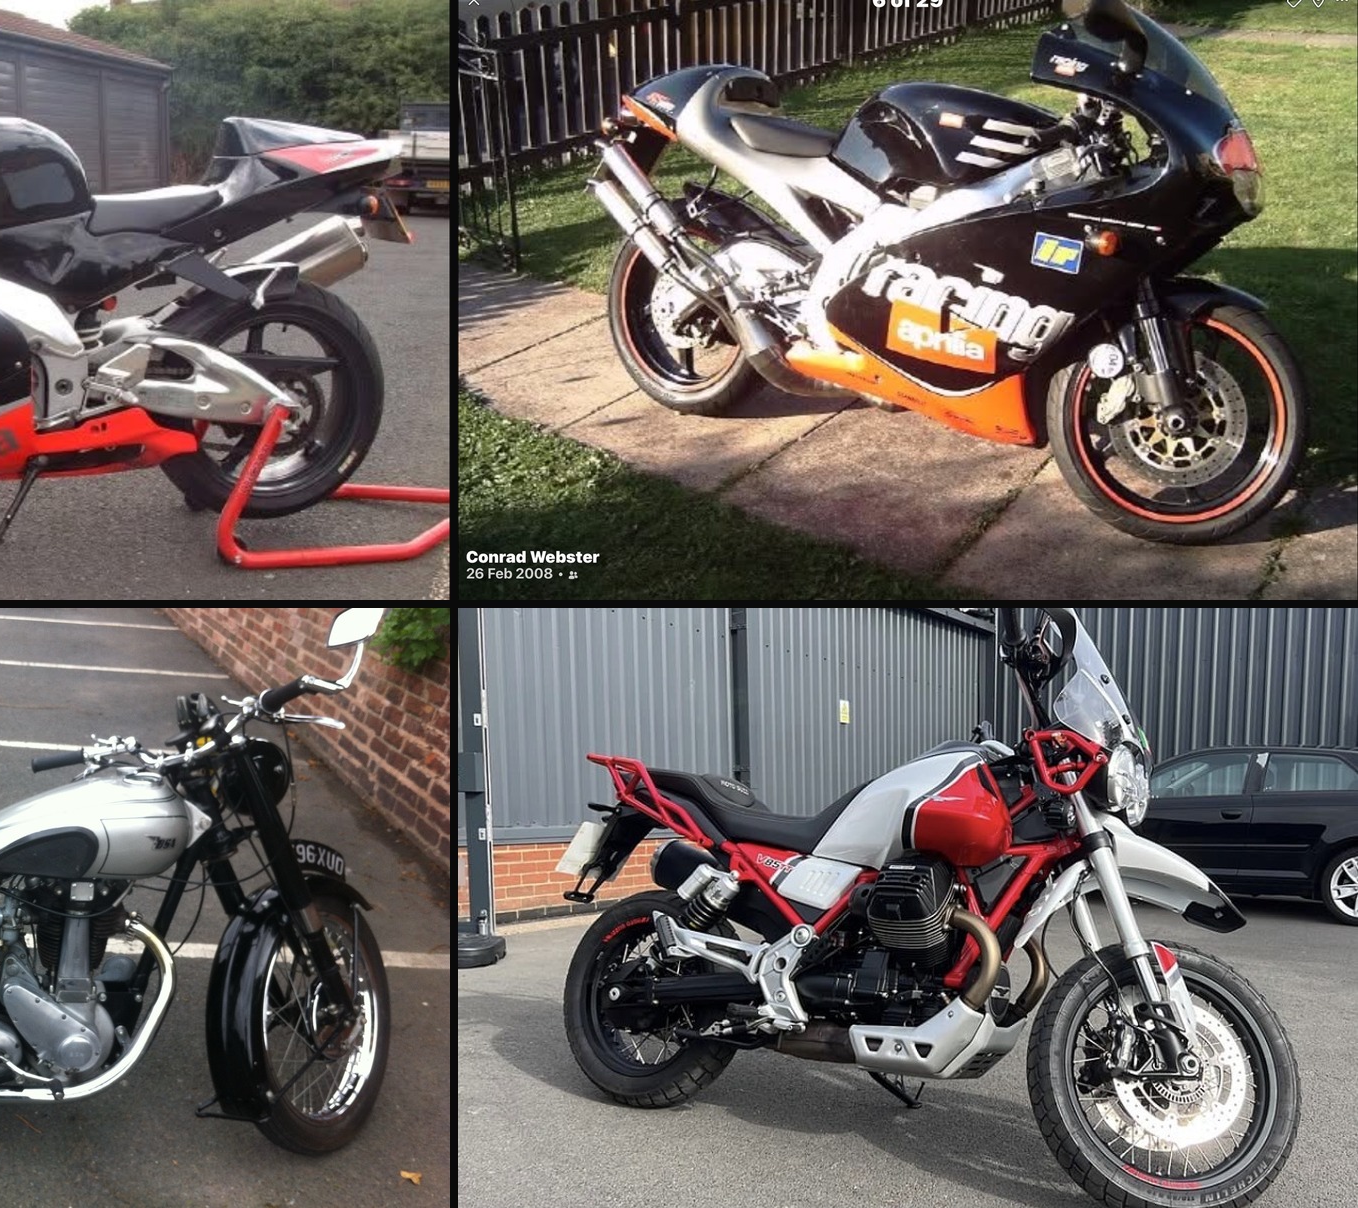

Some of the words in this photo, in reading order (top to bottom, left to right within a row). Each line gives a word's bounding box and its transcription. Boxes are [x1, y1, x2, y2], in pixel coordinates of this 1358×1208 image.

[860, 253, 1076, 362] racing
[896, 318, 985, 361] aprilia
[1204, 1160, 1268, 1203] MICHELIN
